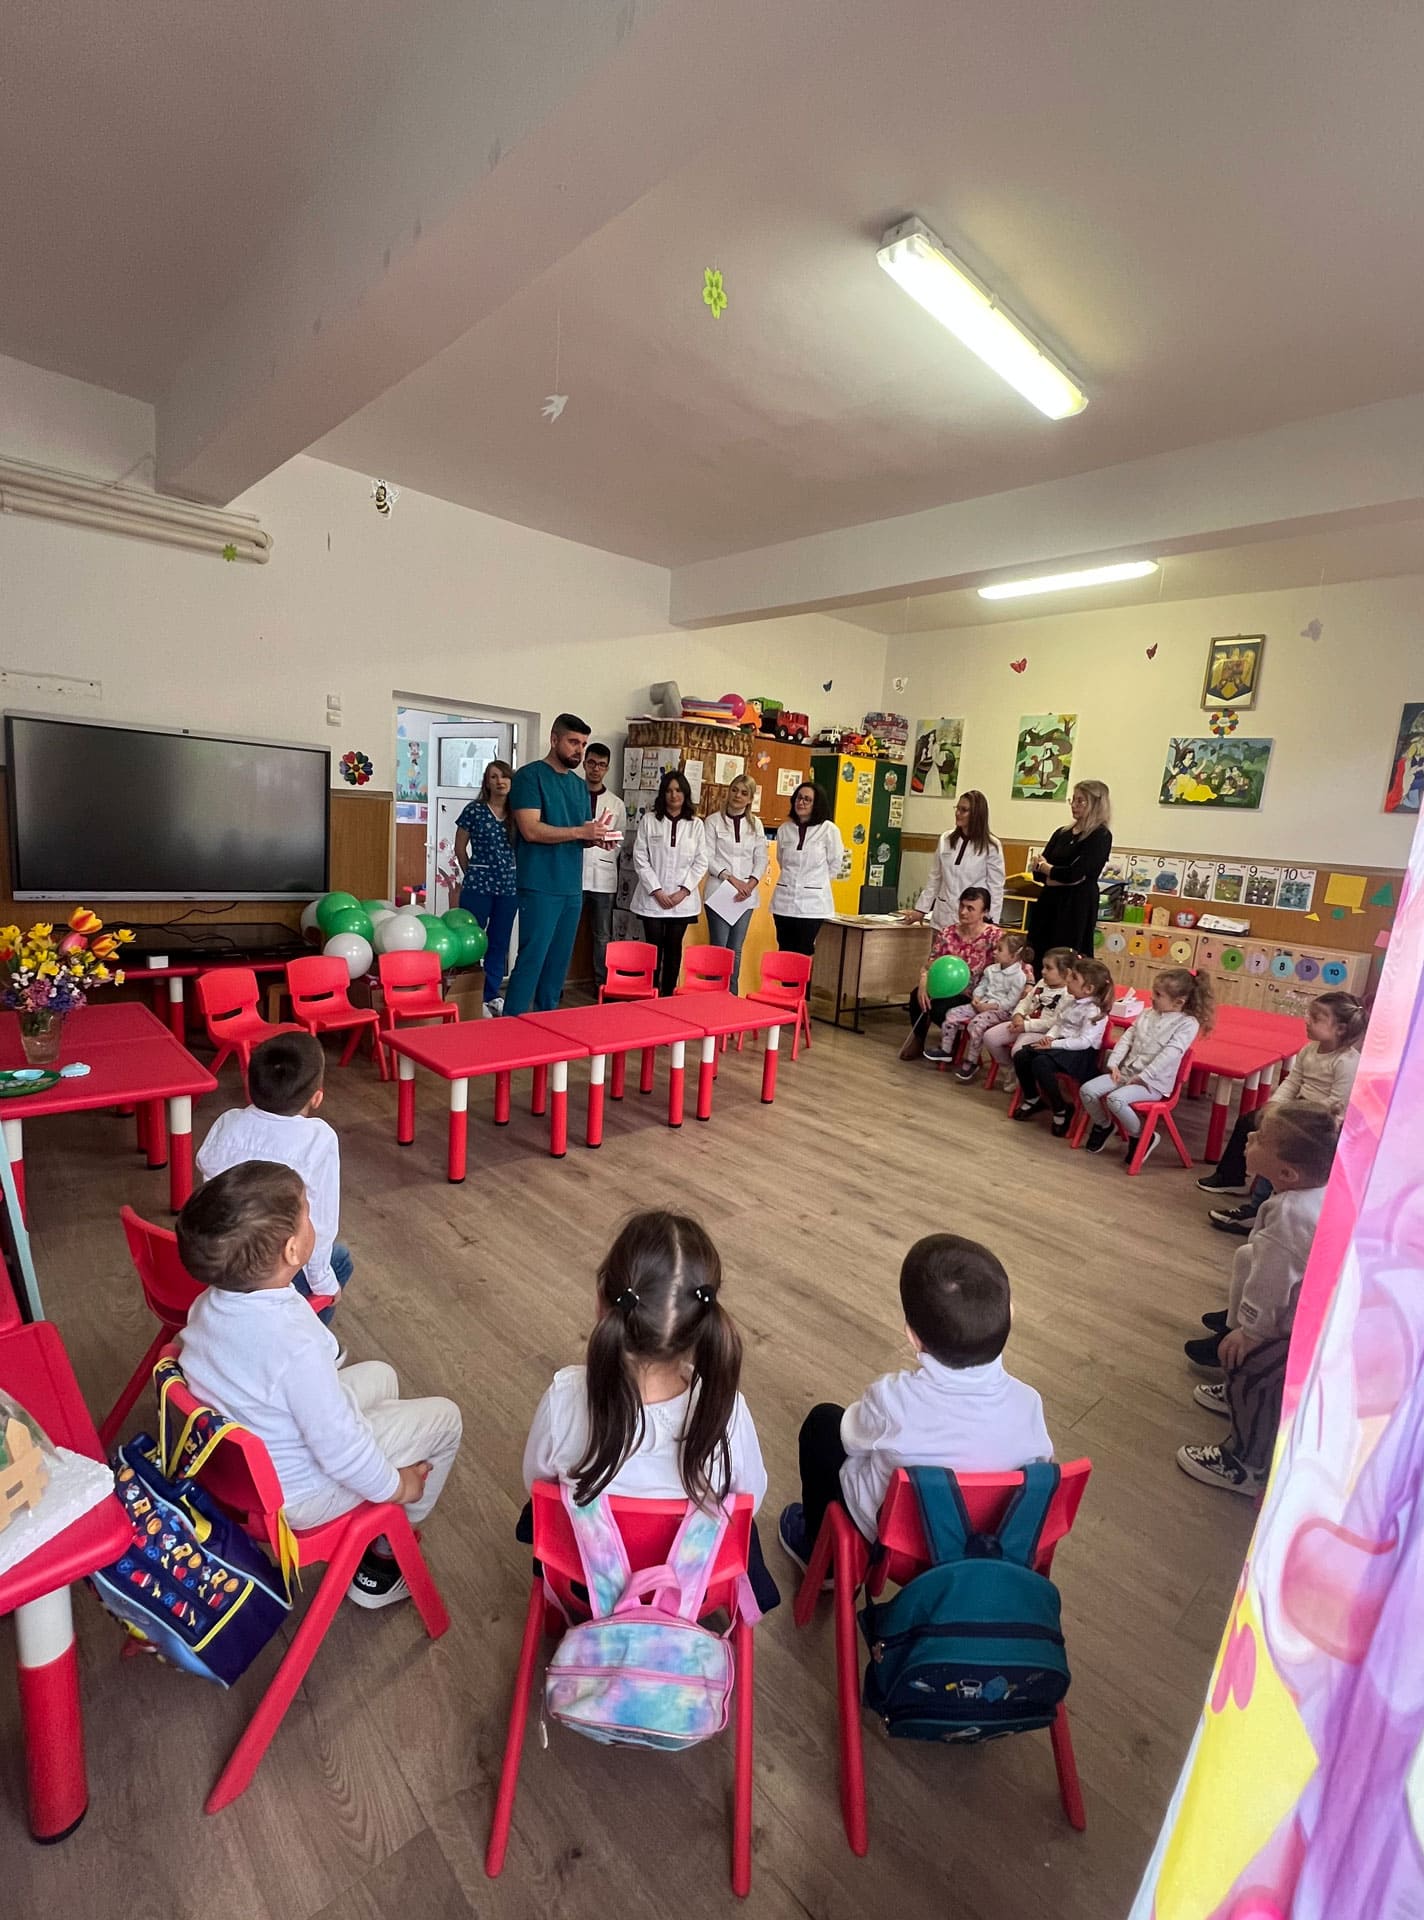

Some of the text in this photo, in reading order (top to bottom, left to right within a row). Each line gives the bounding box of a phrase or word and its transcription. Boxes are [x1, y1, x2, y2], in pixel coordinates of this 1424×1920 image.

[1130, 855, 1137, 866] 5
[1157, 857, 1165, 868] 6
[1188, 860, 1195, 871] 7
[1217, 863, 1225, 875] 8
[1249, 865, 1258, 877] 9
[1284, 868, 1298, 880] 10
[1280, 962, 1286, 971] 8
